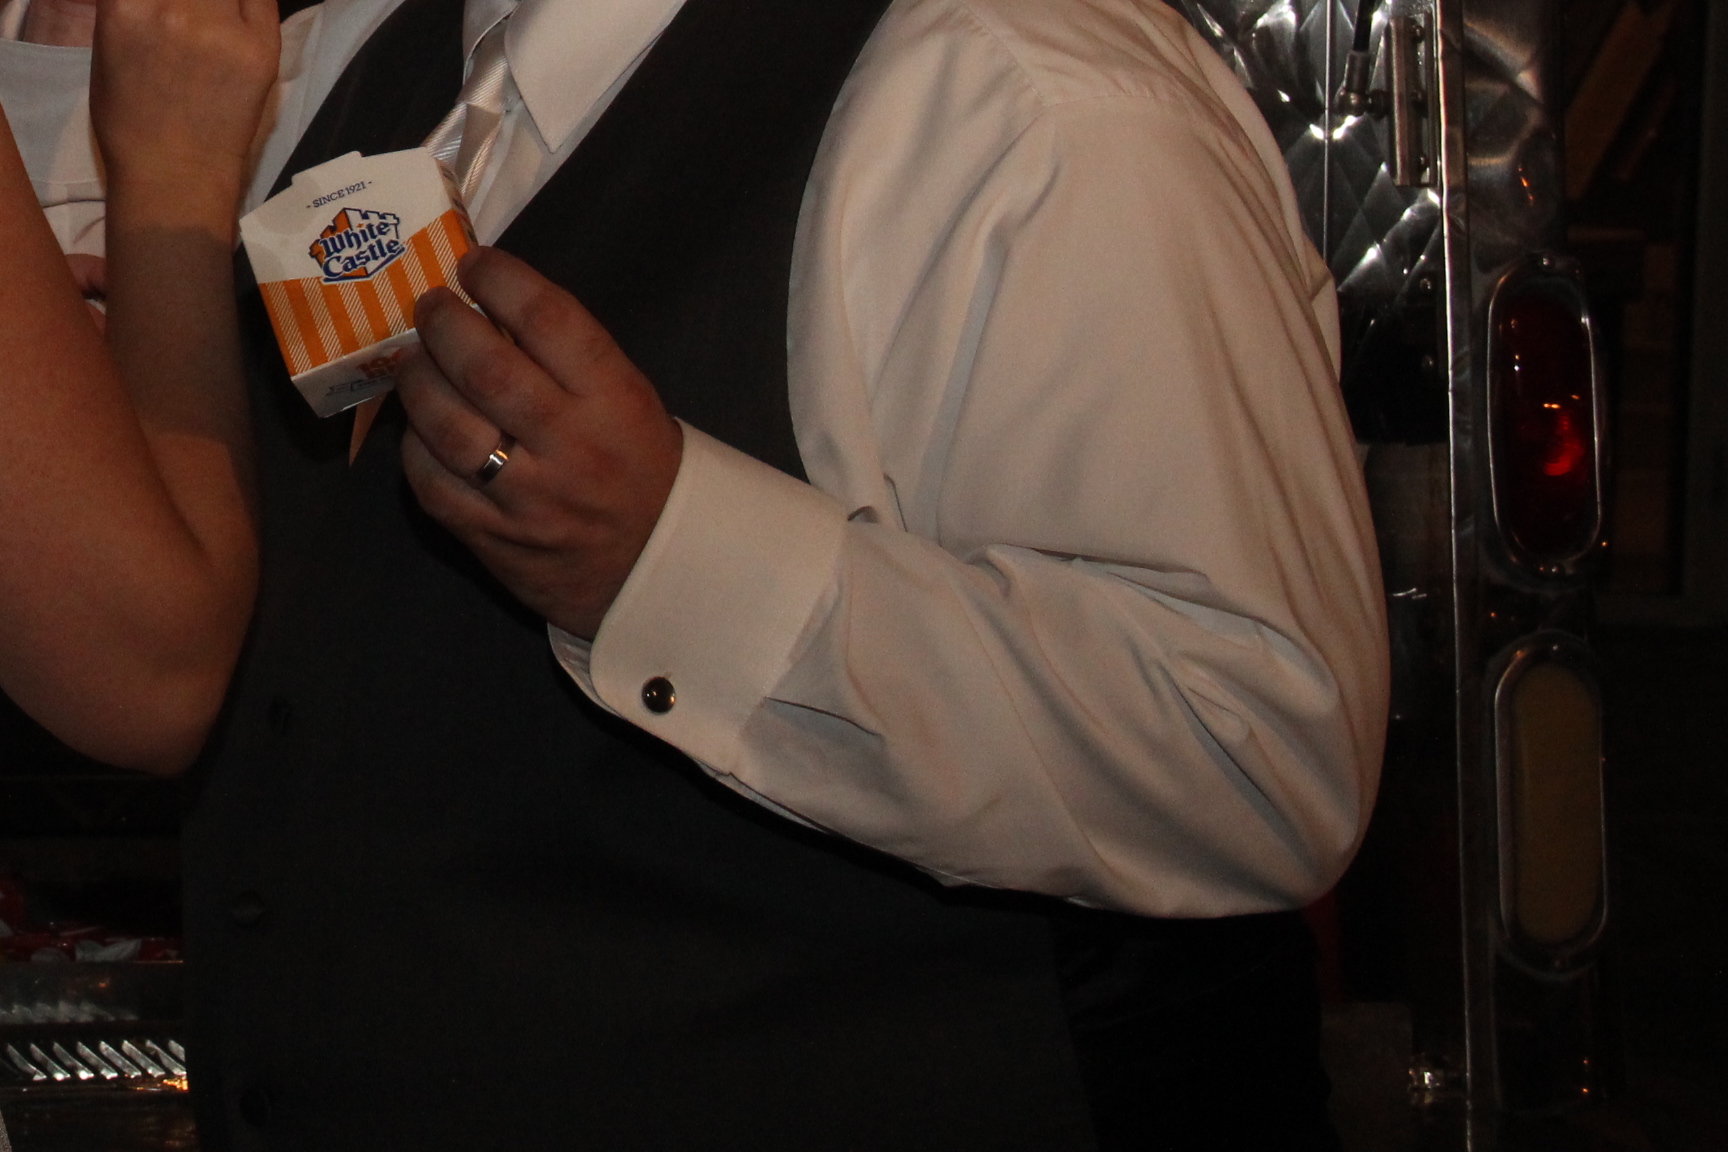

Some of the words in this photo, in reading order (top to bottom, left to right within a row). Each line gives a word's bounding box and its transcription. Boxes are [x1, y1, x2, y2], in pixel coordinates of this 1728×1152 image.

[312, 188, 344, 209] SINCE
[345, 181, 367, 196] 1921
[320, 222, 391, 257] White
[322, 236, 405, 278] Castle
